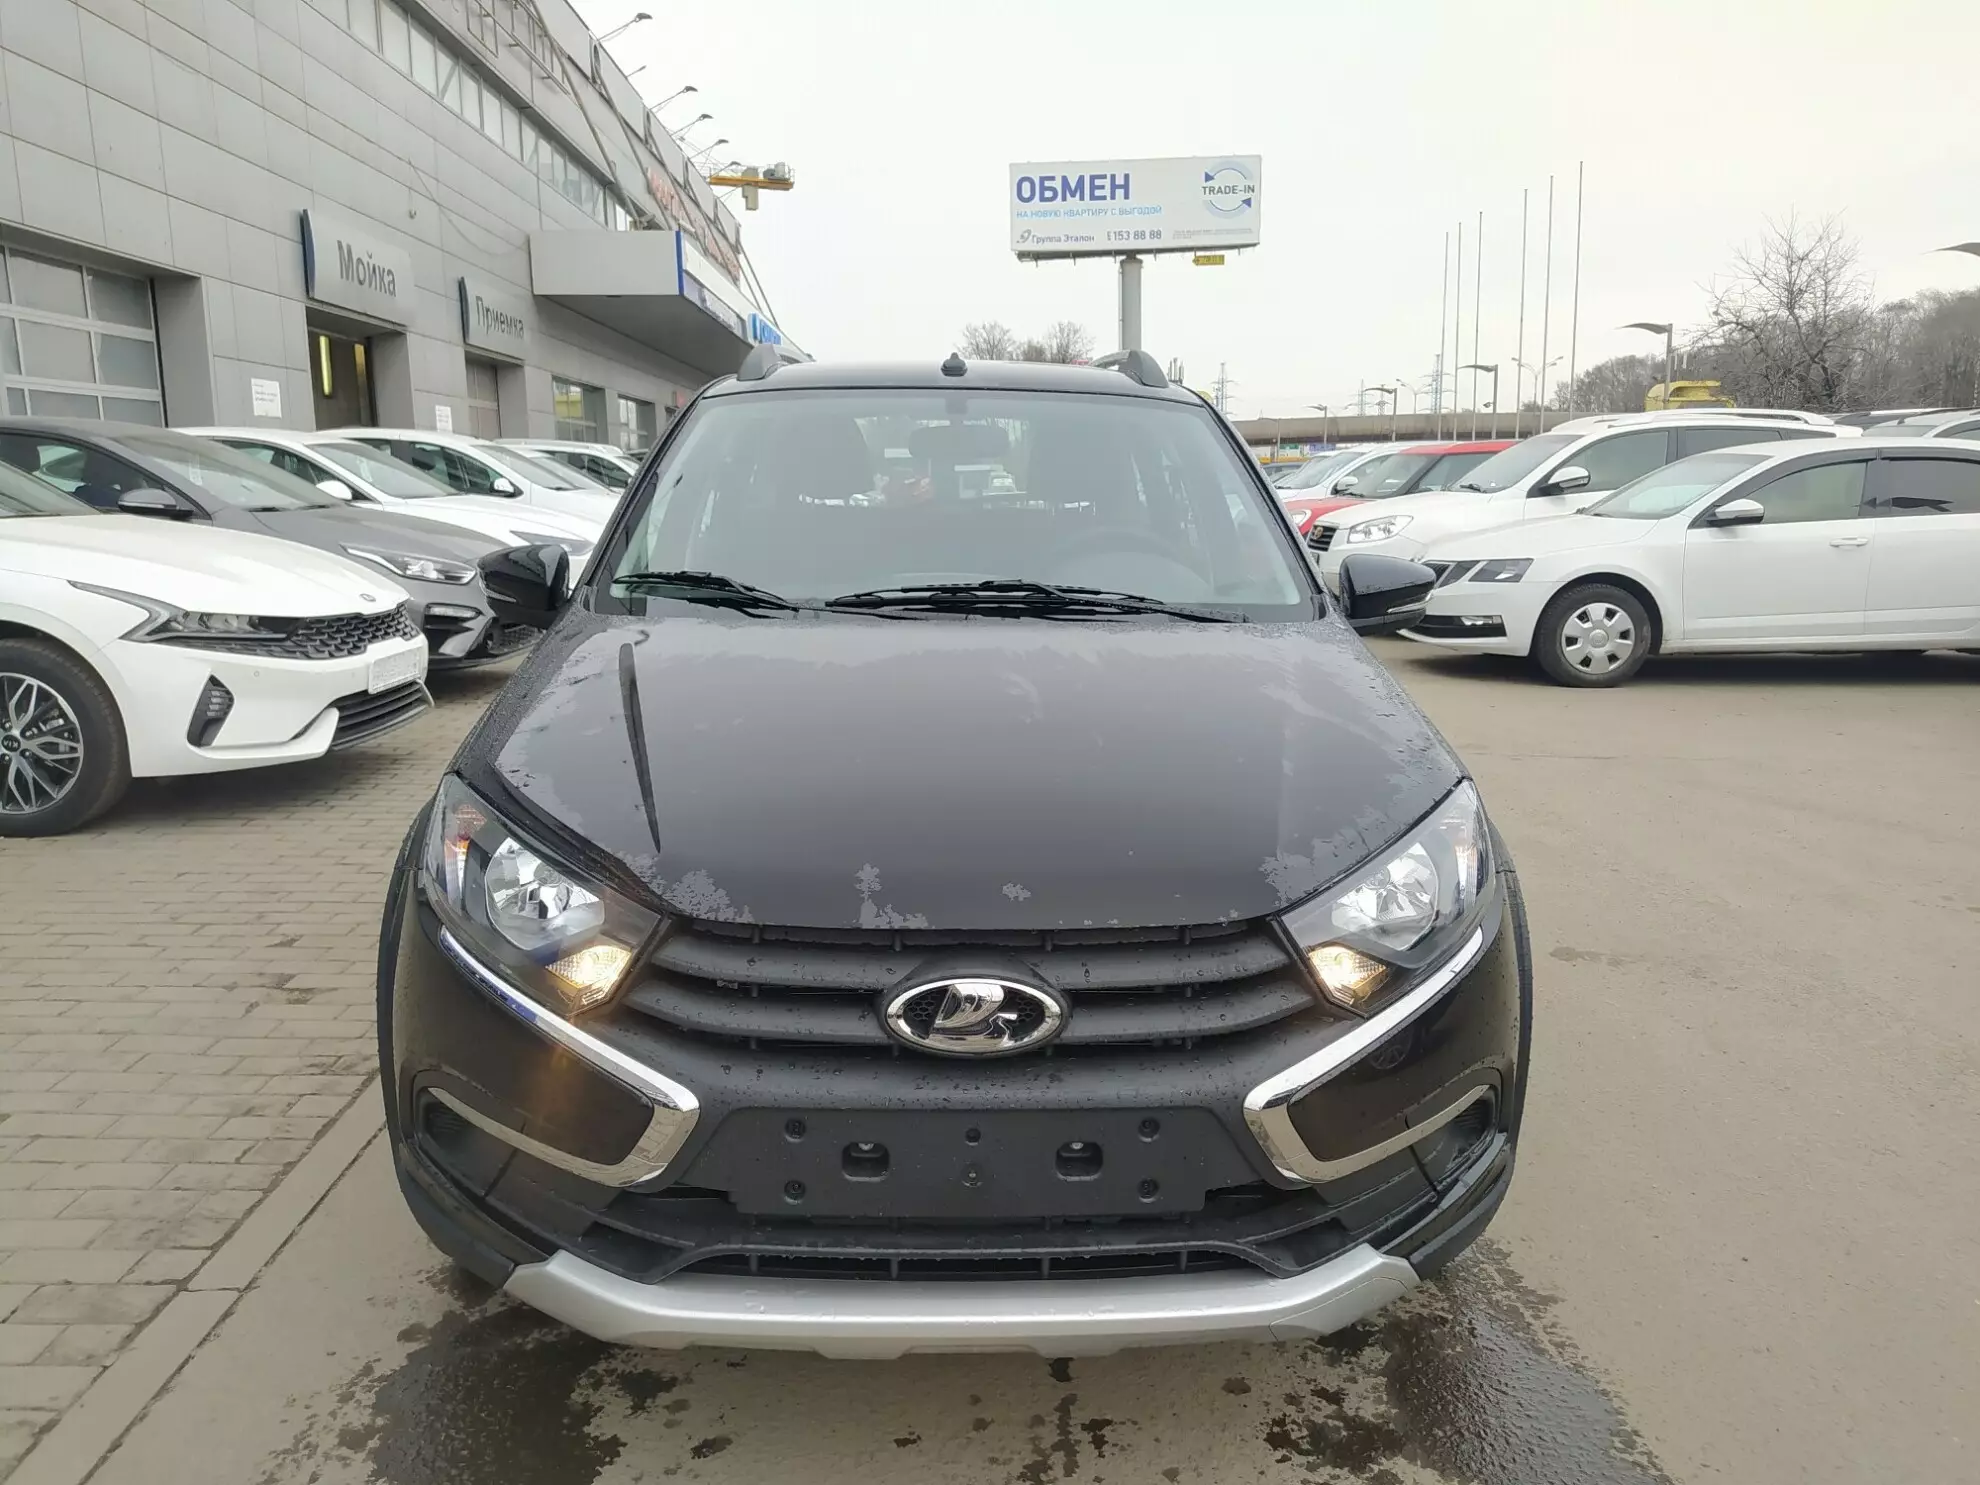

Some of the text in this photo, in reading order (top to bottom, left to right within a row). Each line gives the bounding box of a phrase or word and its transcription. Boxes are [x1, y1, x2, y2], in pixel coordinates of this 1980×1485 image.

[1016, 173, 1130, 204] ОБМЕН
[1202, 184, 1255, 195] TRADE-IN
[1016, 205, 1162, 219] НА НОВУЮ КВАРТИРУ С ВЫГОДОЙ
[1031, 233, 1095, 244] Группа Эталон
[1113, 230, 1130, 241] 153
[1133, 230, 1146, 240] 88
[1149, 229, 1162, 240] 88
[336, 240, 397, 297] Мойка
[475, 295, 525, 340] Приемка
